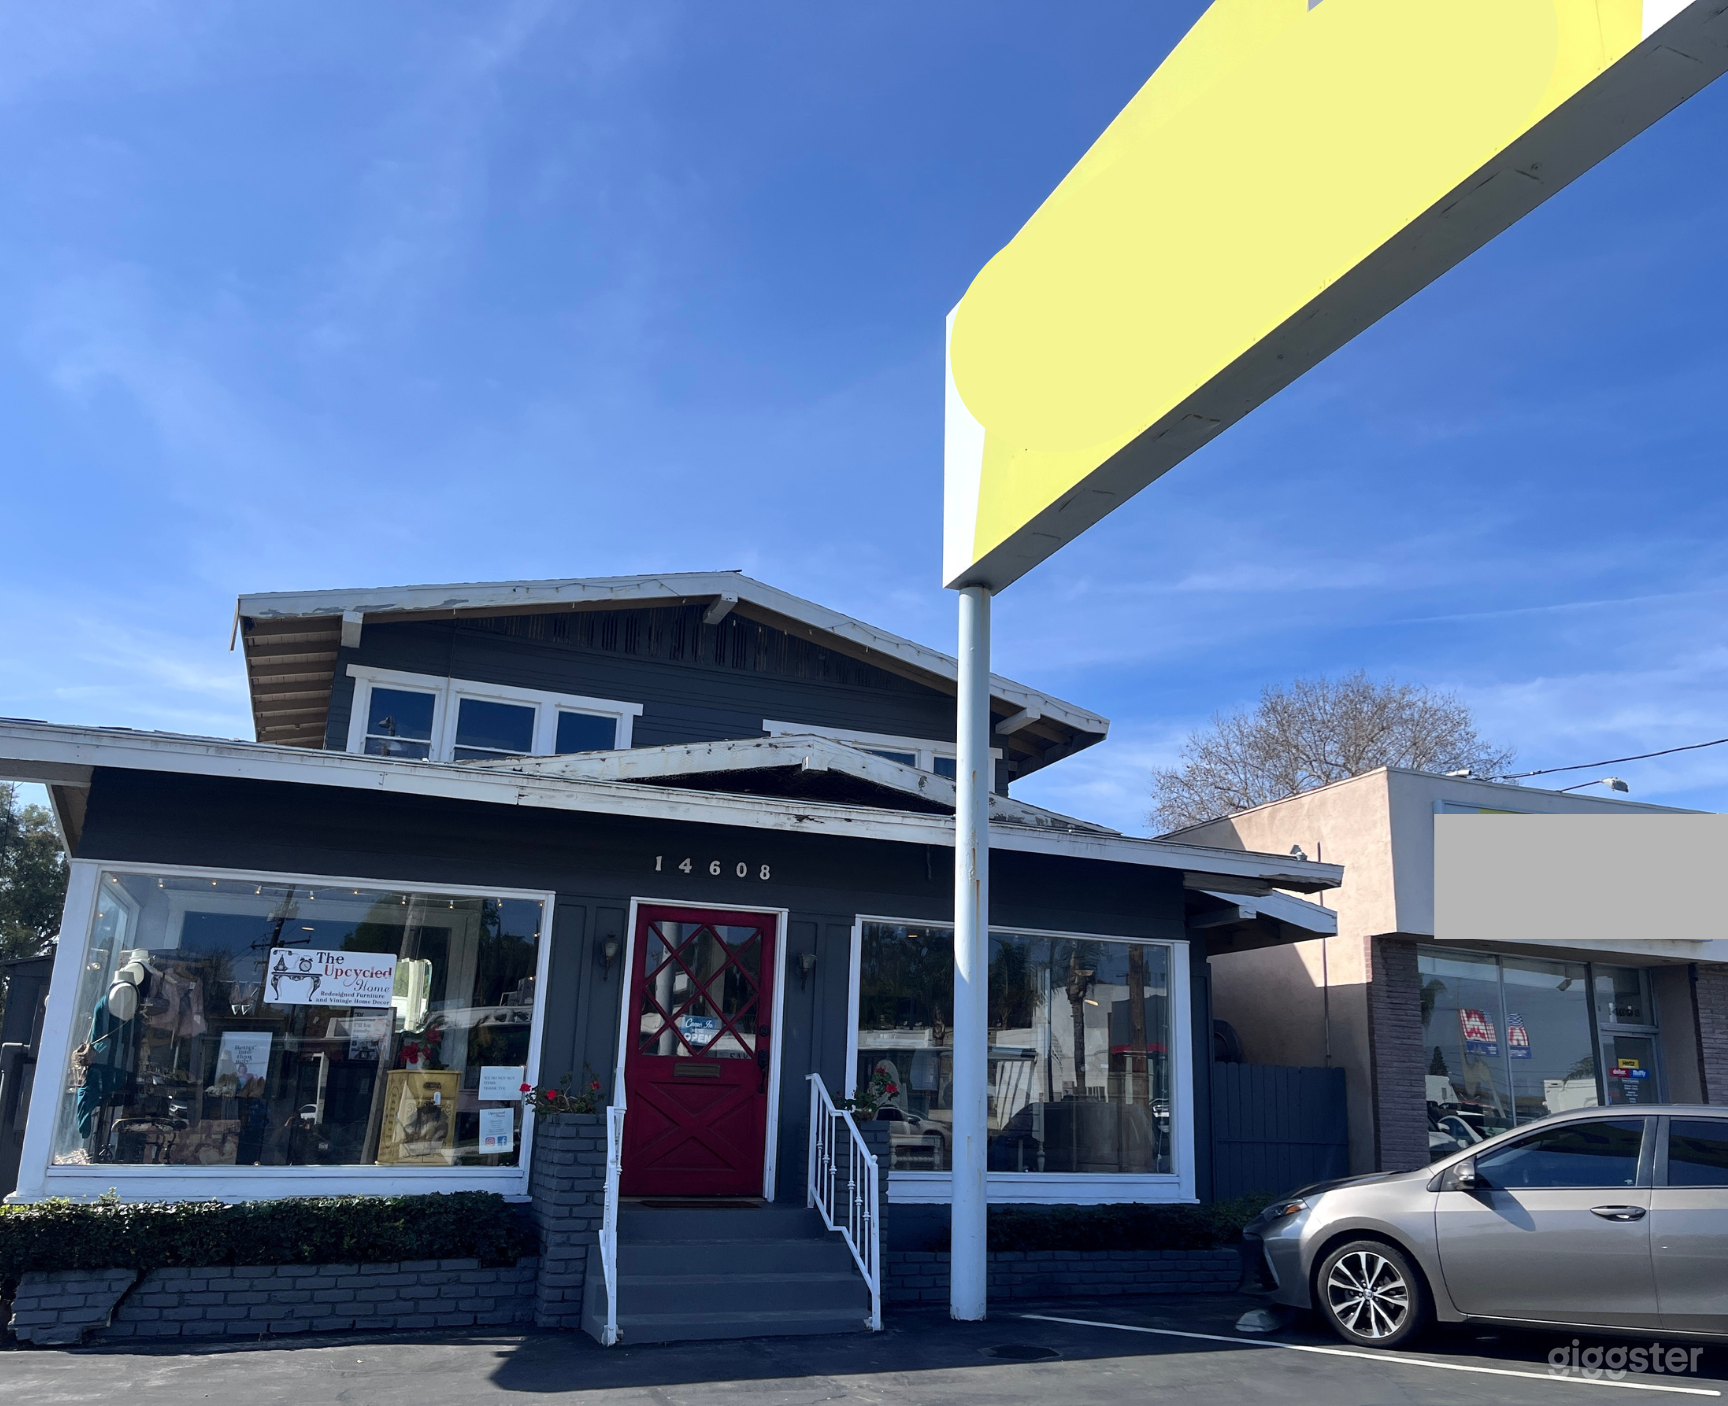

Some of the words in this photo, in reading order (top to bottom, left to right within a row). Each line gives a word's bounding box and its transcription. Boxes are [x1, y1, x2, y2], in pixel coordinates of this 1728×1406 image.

[655, 855, 770, 880] 14608
[316, 951, 345, 965] The
[324, 964, 393, 987] Upcycled
[354, 979, 390, 992] Home
[684, 1032, 711, 1044] OPEN
